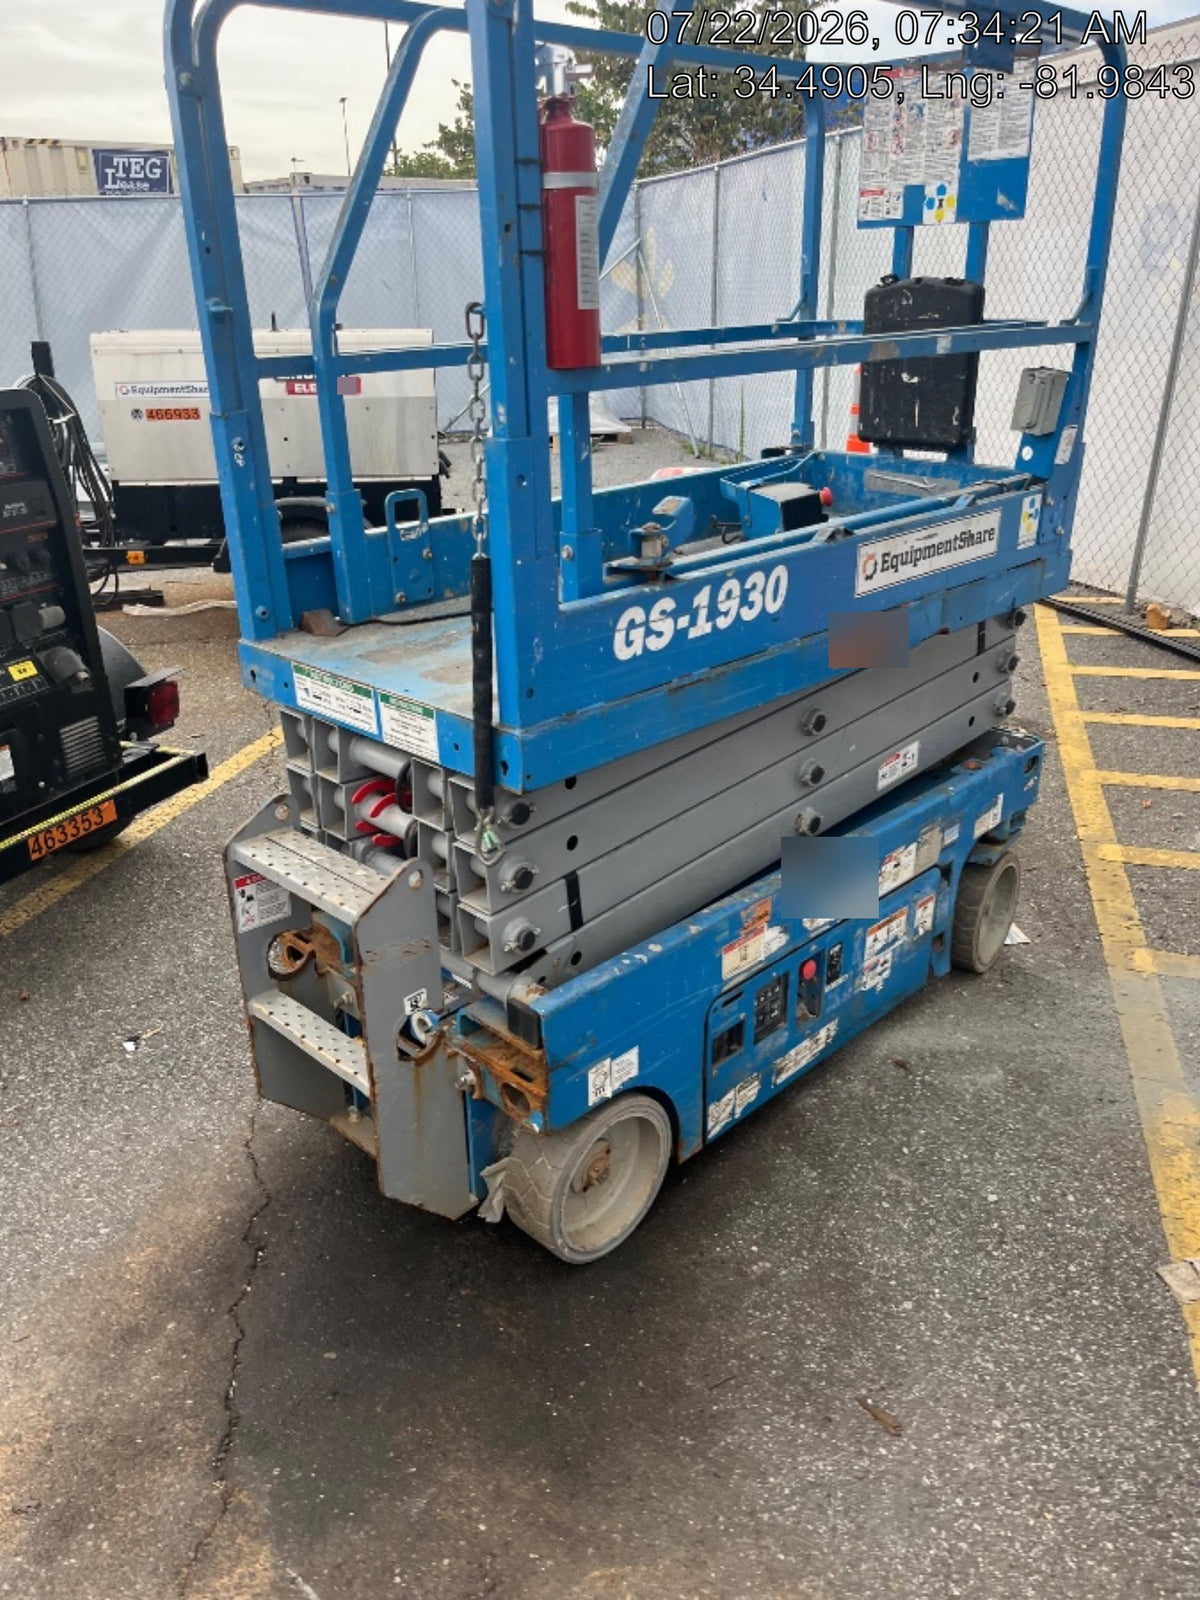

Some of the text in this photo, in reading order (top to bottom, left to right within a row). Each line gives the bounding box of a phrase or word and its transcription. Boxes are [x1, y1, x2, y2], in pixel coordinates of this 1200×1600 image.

[130, 385, 208, 396] EquipmentShar
[879, 527, 996, 573] EquipmentShare
[613, 564, 789, 661] GS-1930
[31, 806, 104, 856] 463353
